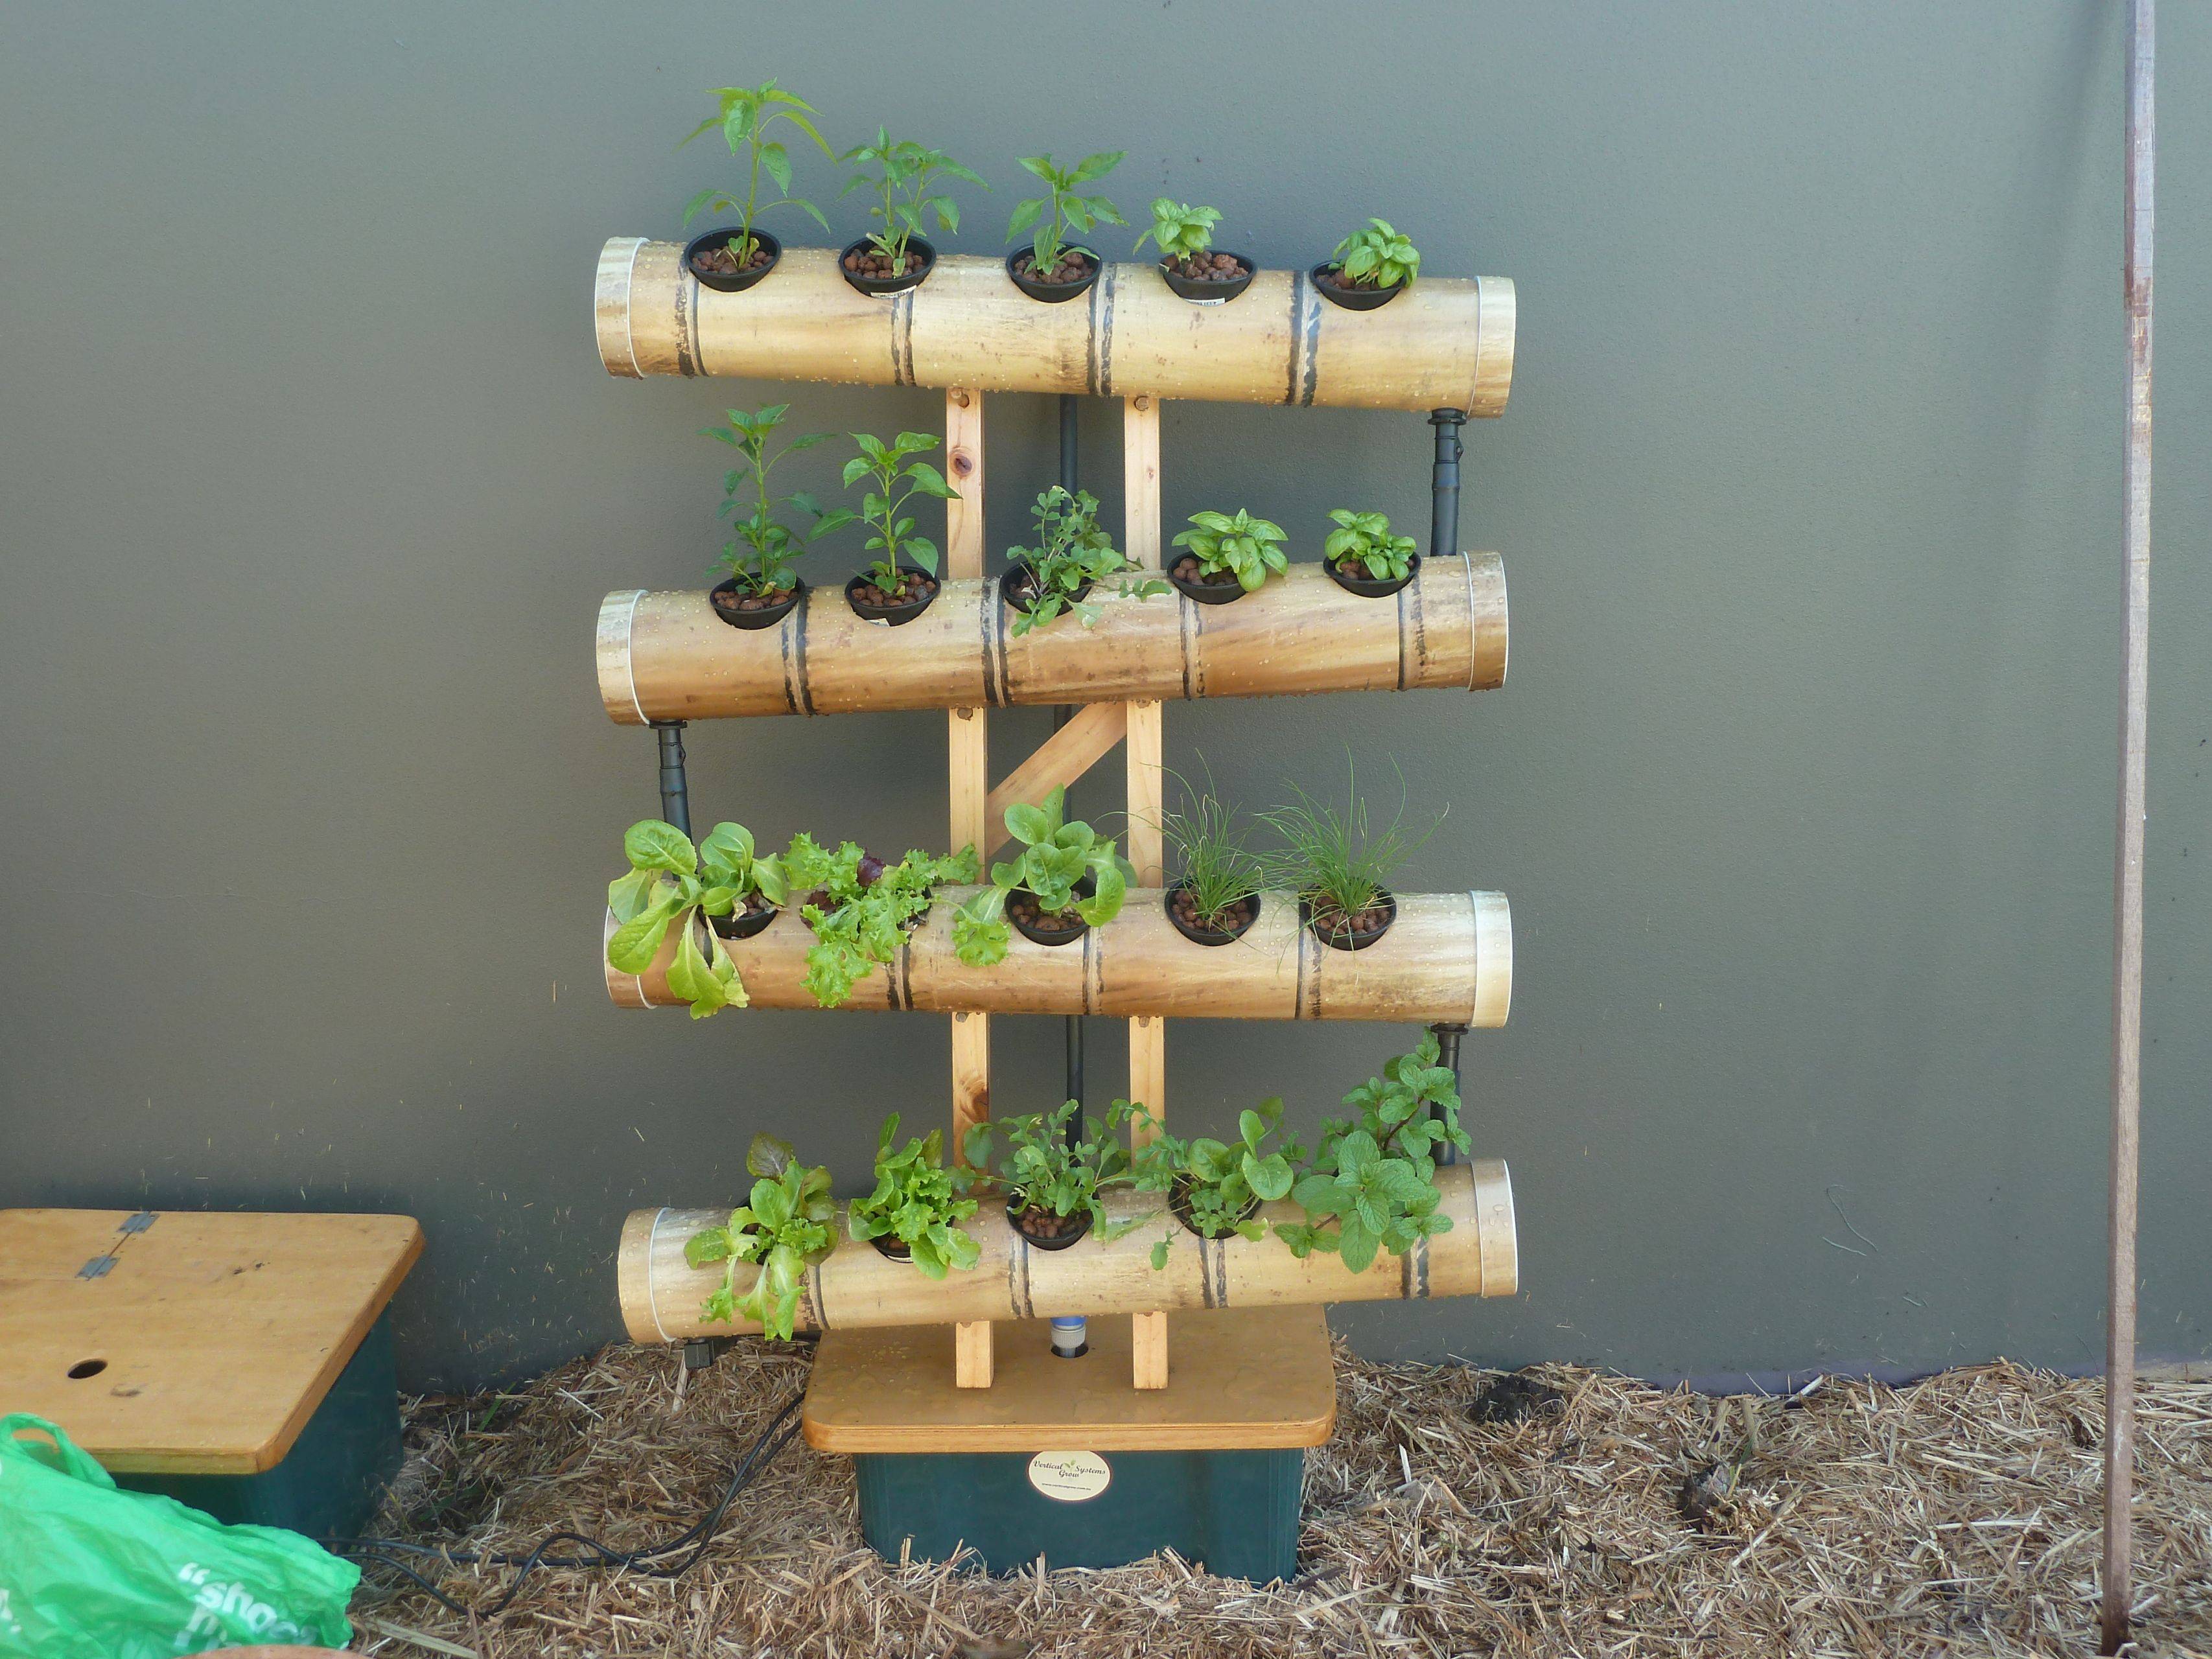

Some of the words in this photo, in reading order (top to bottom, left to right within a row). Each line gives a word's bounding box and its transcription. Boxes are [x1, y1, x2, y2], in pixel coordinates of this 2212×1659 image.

[1033, 1460, 1063, 1470] Vertical
[1058, 1469, 1079, 1478] Grow
[1075, 1465, 1106, 1475] Systems
